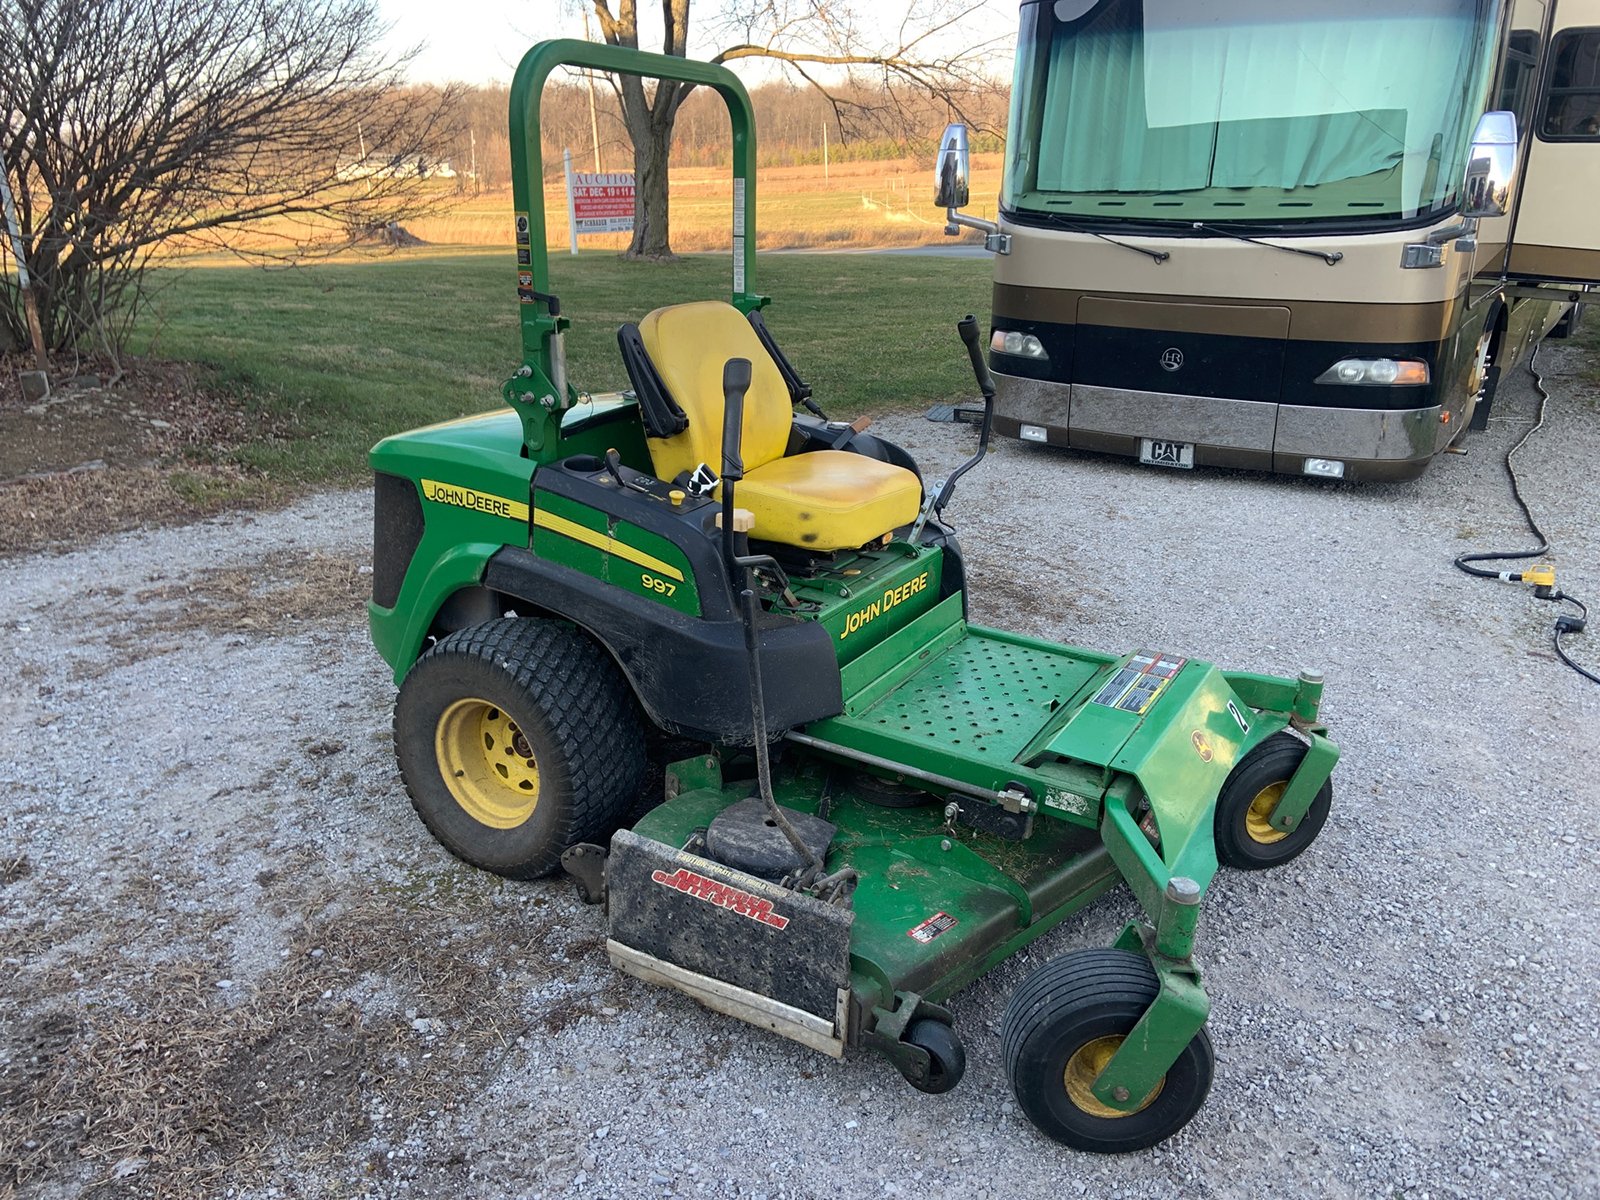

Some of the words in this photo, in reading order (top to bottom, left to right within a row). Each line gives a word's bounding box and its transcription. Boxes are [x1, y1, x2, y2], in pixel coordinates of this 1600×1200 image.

[573, 188, 588, 197] SAT.
[589, 187, 606, 197] DEC.
[607, 187, 615, 196] 19
[621, 187, 629, 196] 11
[630, 187, 636, 196] A
[1151, 442, 1184, 463] CAT
[430, 484, 463, 504] JOHN
[466, 491, 510, 516] DEERE
[641, 574, 676, 597] 997
[840, 599, 881, 639] JOHN
[883, 572, 928, 612] DEERE
[1228, 702, 1250, 733] 2
[675, 868, 774, 913] ADVANCED
